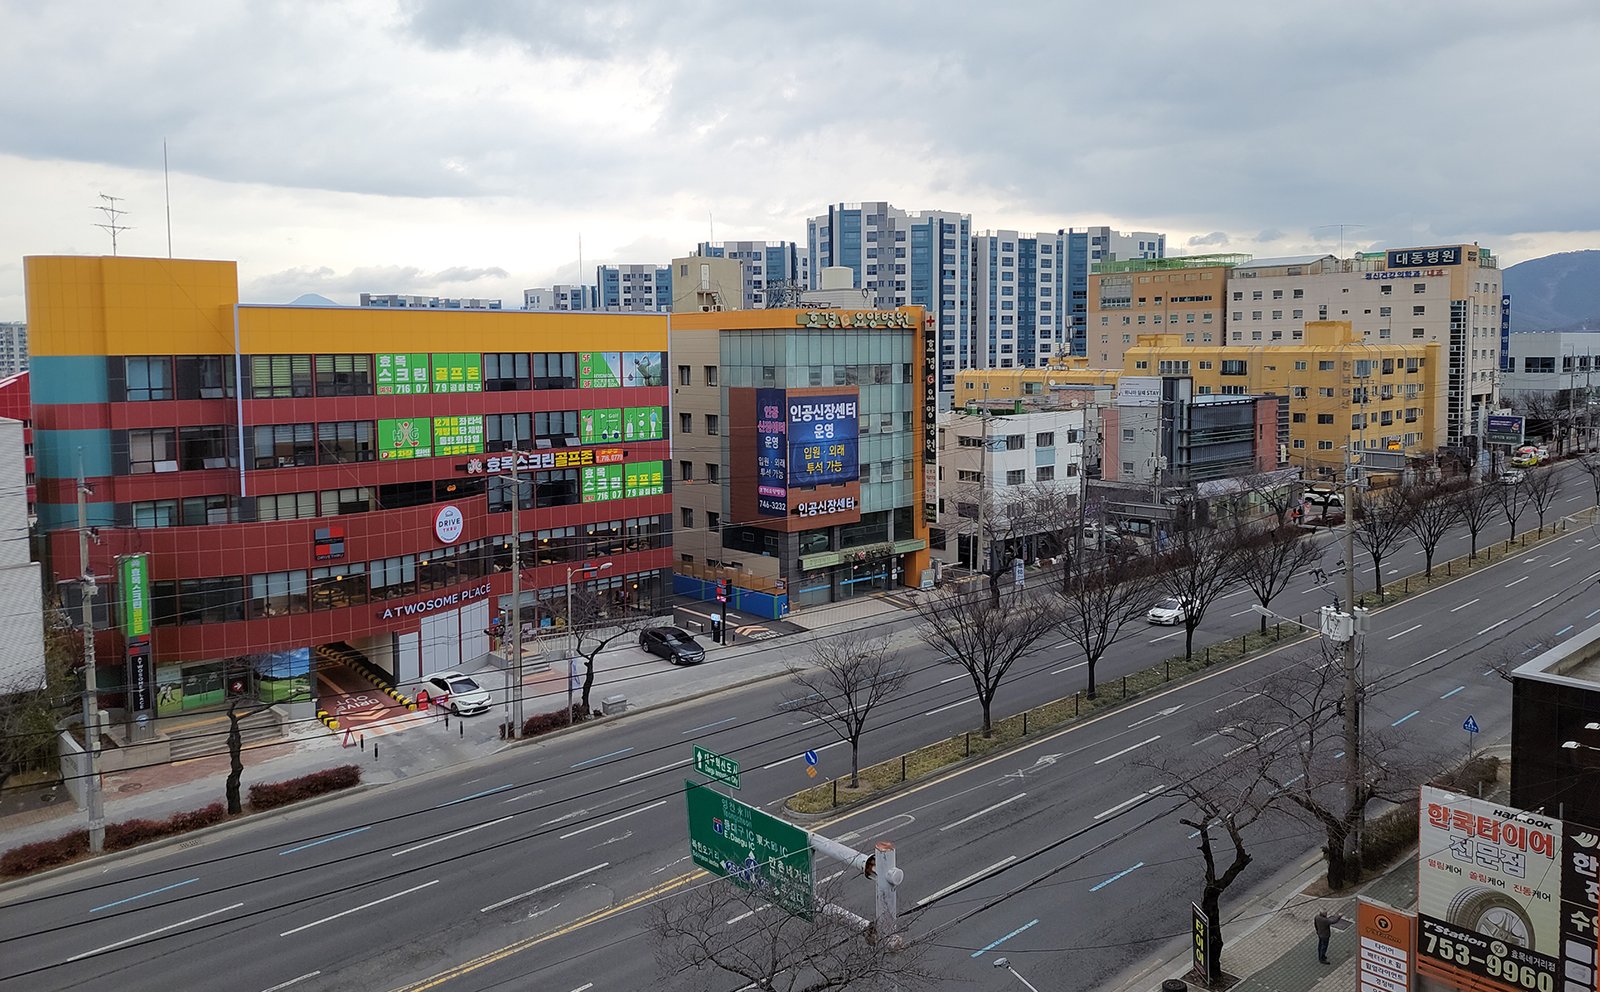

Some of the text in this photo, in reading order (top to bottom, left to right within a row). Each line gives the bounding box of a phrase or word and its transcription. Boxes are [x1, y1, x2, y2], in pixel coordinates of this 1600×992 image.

[1396, 249, 1454, 265] 대동병원
[854, 311, 909, 328] 요양병원
[380, 355, 406, 367] 효목
[582, 354, 591, 362] 5F
[379, 367, 479, 382] 스크린 골프존
[396, 384, 410, 393] 716
[790, 401, 856, 422] 인공신장센터
[926, 388, 936, 453] 요양병원
[814, 423, 834, 439] 운영
[765, 435, 779, 449] 운영
[803, 444, 845, 460] 입원 외래
[758, 456, 786, 468] 입원 외래
[806, 460, 842, 475] 투석 가능
[584, 472, 661, 491] 스크린 골프존
[760, 467, 784, 480] 투석 가능
[597, 492, 609, 500] 716
[759, 499, 786, 511] 746-3232
[798, 496, 855, 518] 인공신장센터
[438, 517, 461, 528] DRIVE
[382, 583, 491, 619] A TWOSOME PLACE
[722, 798, 736, 814] 영천
[724, 819, 744, 837] 동대구
[745, 829, 755, 842] IC
[1427, 802, 1556, 860] 한국타이어
[748, 841, 756, 851] IC
[1449, 834, 1526, 879] 전문점
[1513, 884, 1552, 902] 진동케어
[1374, 942, 1395, 955] 타이어
[1367, 951, 1387, 964] 배터리
[1424, 931, 1554, 992] 753-9960
[1510, 949, 1556, 973] 효목네거리점
